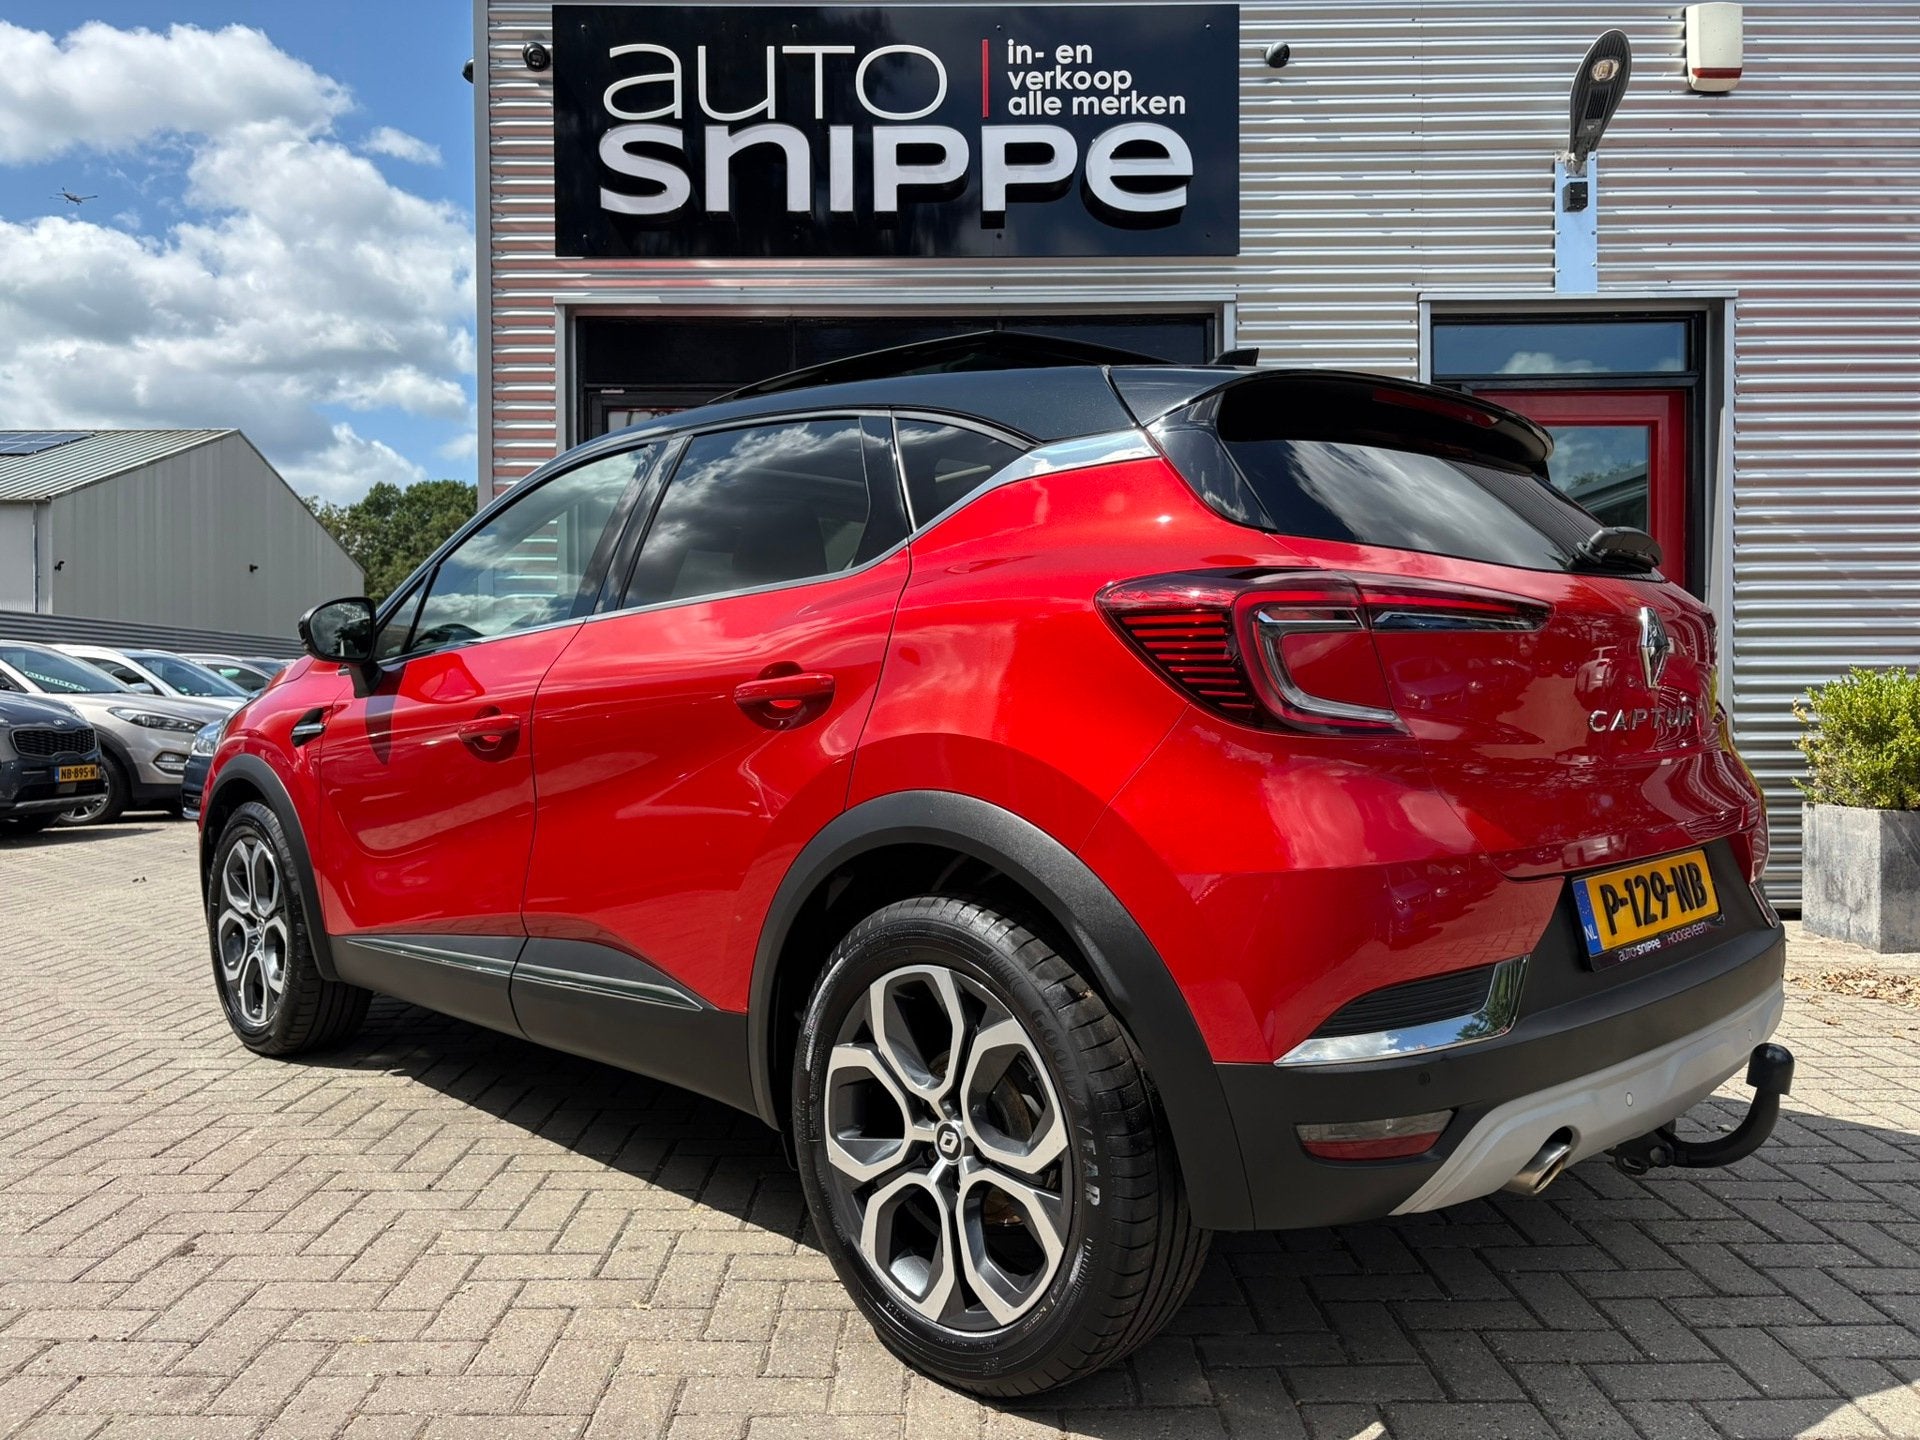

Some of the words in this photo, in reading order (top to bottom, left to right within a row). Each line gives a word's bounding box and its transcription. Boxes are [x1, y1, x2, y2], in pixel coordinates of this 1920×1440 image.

[1007, 38, 1045, 65] in-
[1055, 44, 1093, 64] en
[1007, 65, 1132, 95] verkoop
[1008, 91, 1062, 116] alle
[1072, 90, 1186, 115] merken
[1589, 707, 1694, 733] CAPTUR
[1599, 861, 1708, 936] P-129-NB
[1583, 923, 1598, 942] NL
